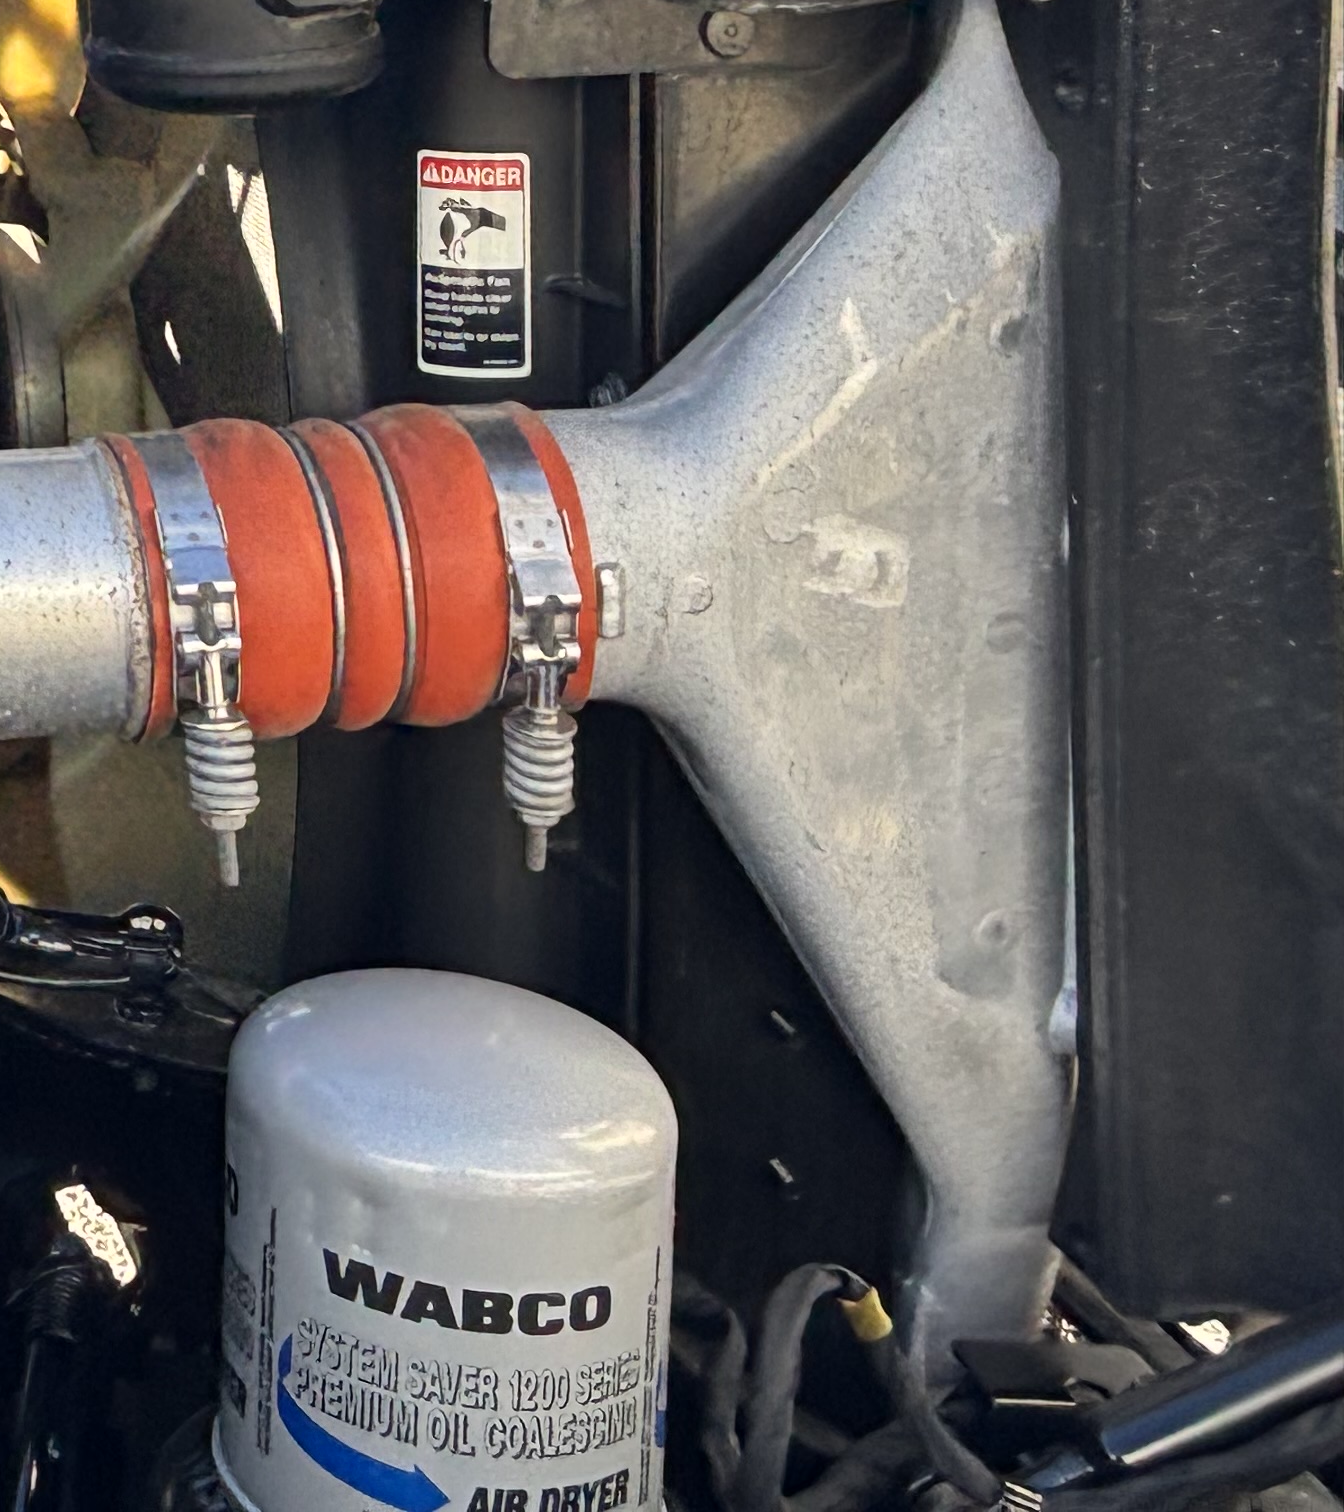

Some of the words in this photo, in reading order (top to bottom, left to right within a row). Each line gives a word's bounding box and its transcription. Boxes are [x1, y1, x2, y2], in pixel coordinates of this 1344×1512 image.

[440, 165, 521, 186] DANGER
[323, 1248, 611, 1335] WABCO
[297, 1317, 400, 1394] SYSTEM
[407, 1357, 498, 1412] SAVER
[509, 1367, 570, 1412] 1200
[294, 1367, 418, 1448] PREMIUM
[427, 1407, 476, 1458] OIL
[466, 1486, 529, 1512] AIR
[540, 1468, 630, 1512] DRYER
